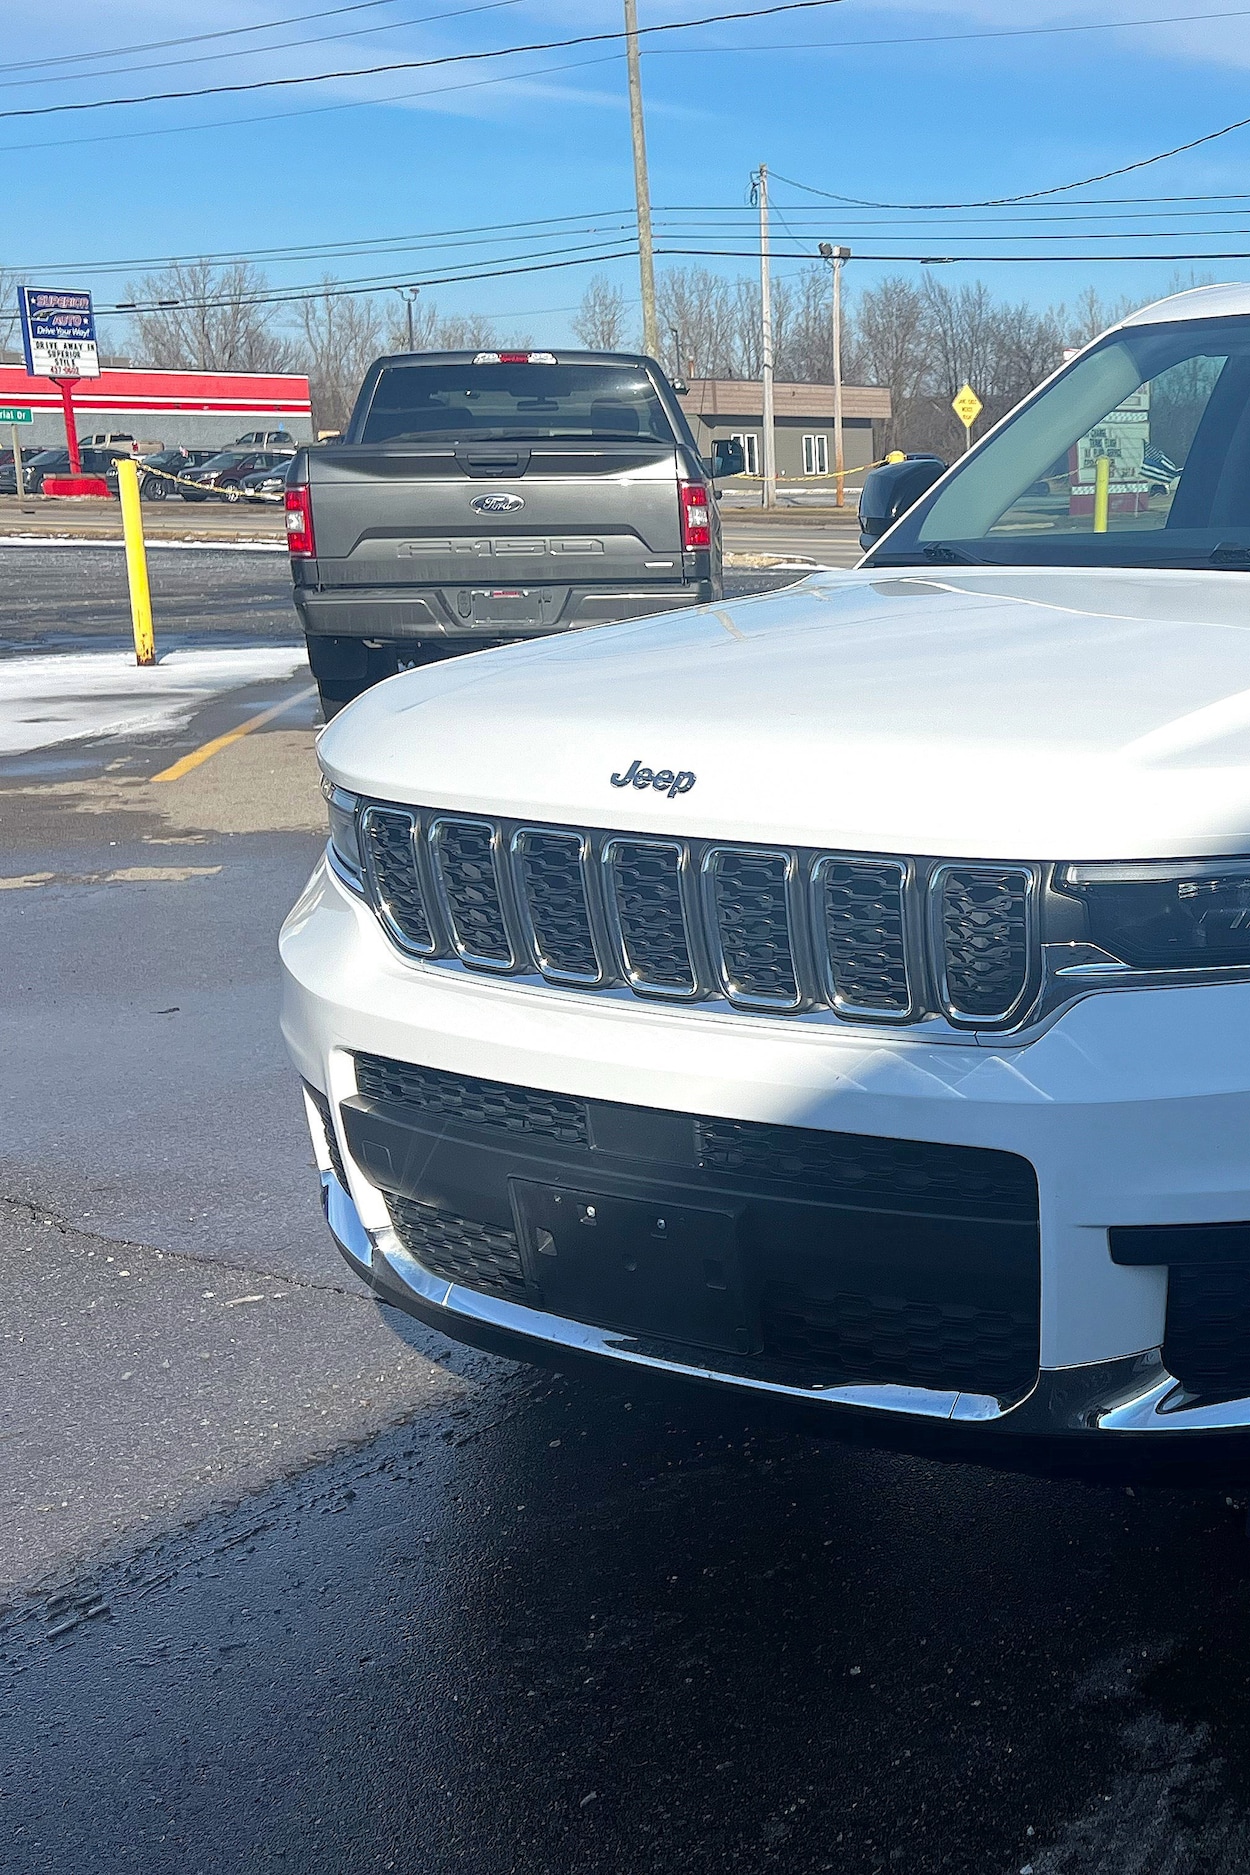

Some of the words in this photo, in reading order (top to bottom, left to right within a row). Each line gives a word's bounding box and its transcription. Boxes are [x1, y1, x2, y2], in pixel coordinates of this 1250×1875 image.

[52, 315, 82, 327] AUTO
[37, 326, 56, 335] Drive
[56, 327, 72, 336] Your
[36, 341, 58, 351] DRIVE
[63, 342, 82, 351] AWAY
[87, 344, 95, 352] IN
[47, 350, 81, 358] SUPERIOR
[16, 411, 26, 420] Dr
[482, 495, 512, 511] Ford
[398, 538, 605, 558] F-150
[609, 759, 698, 799] Jeep
